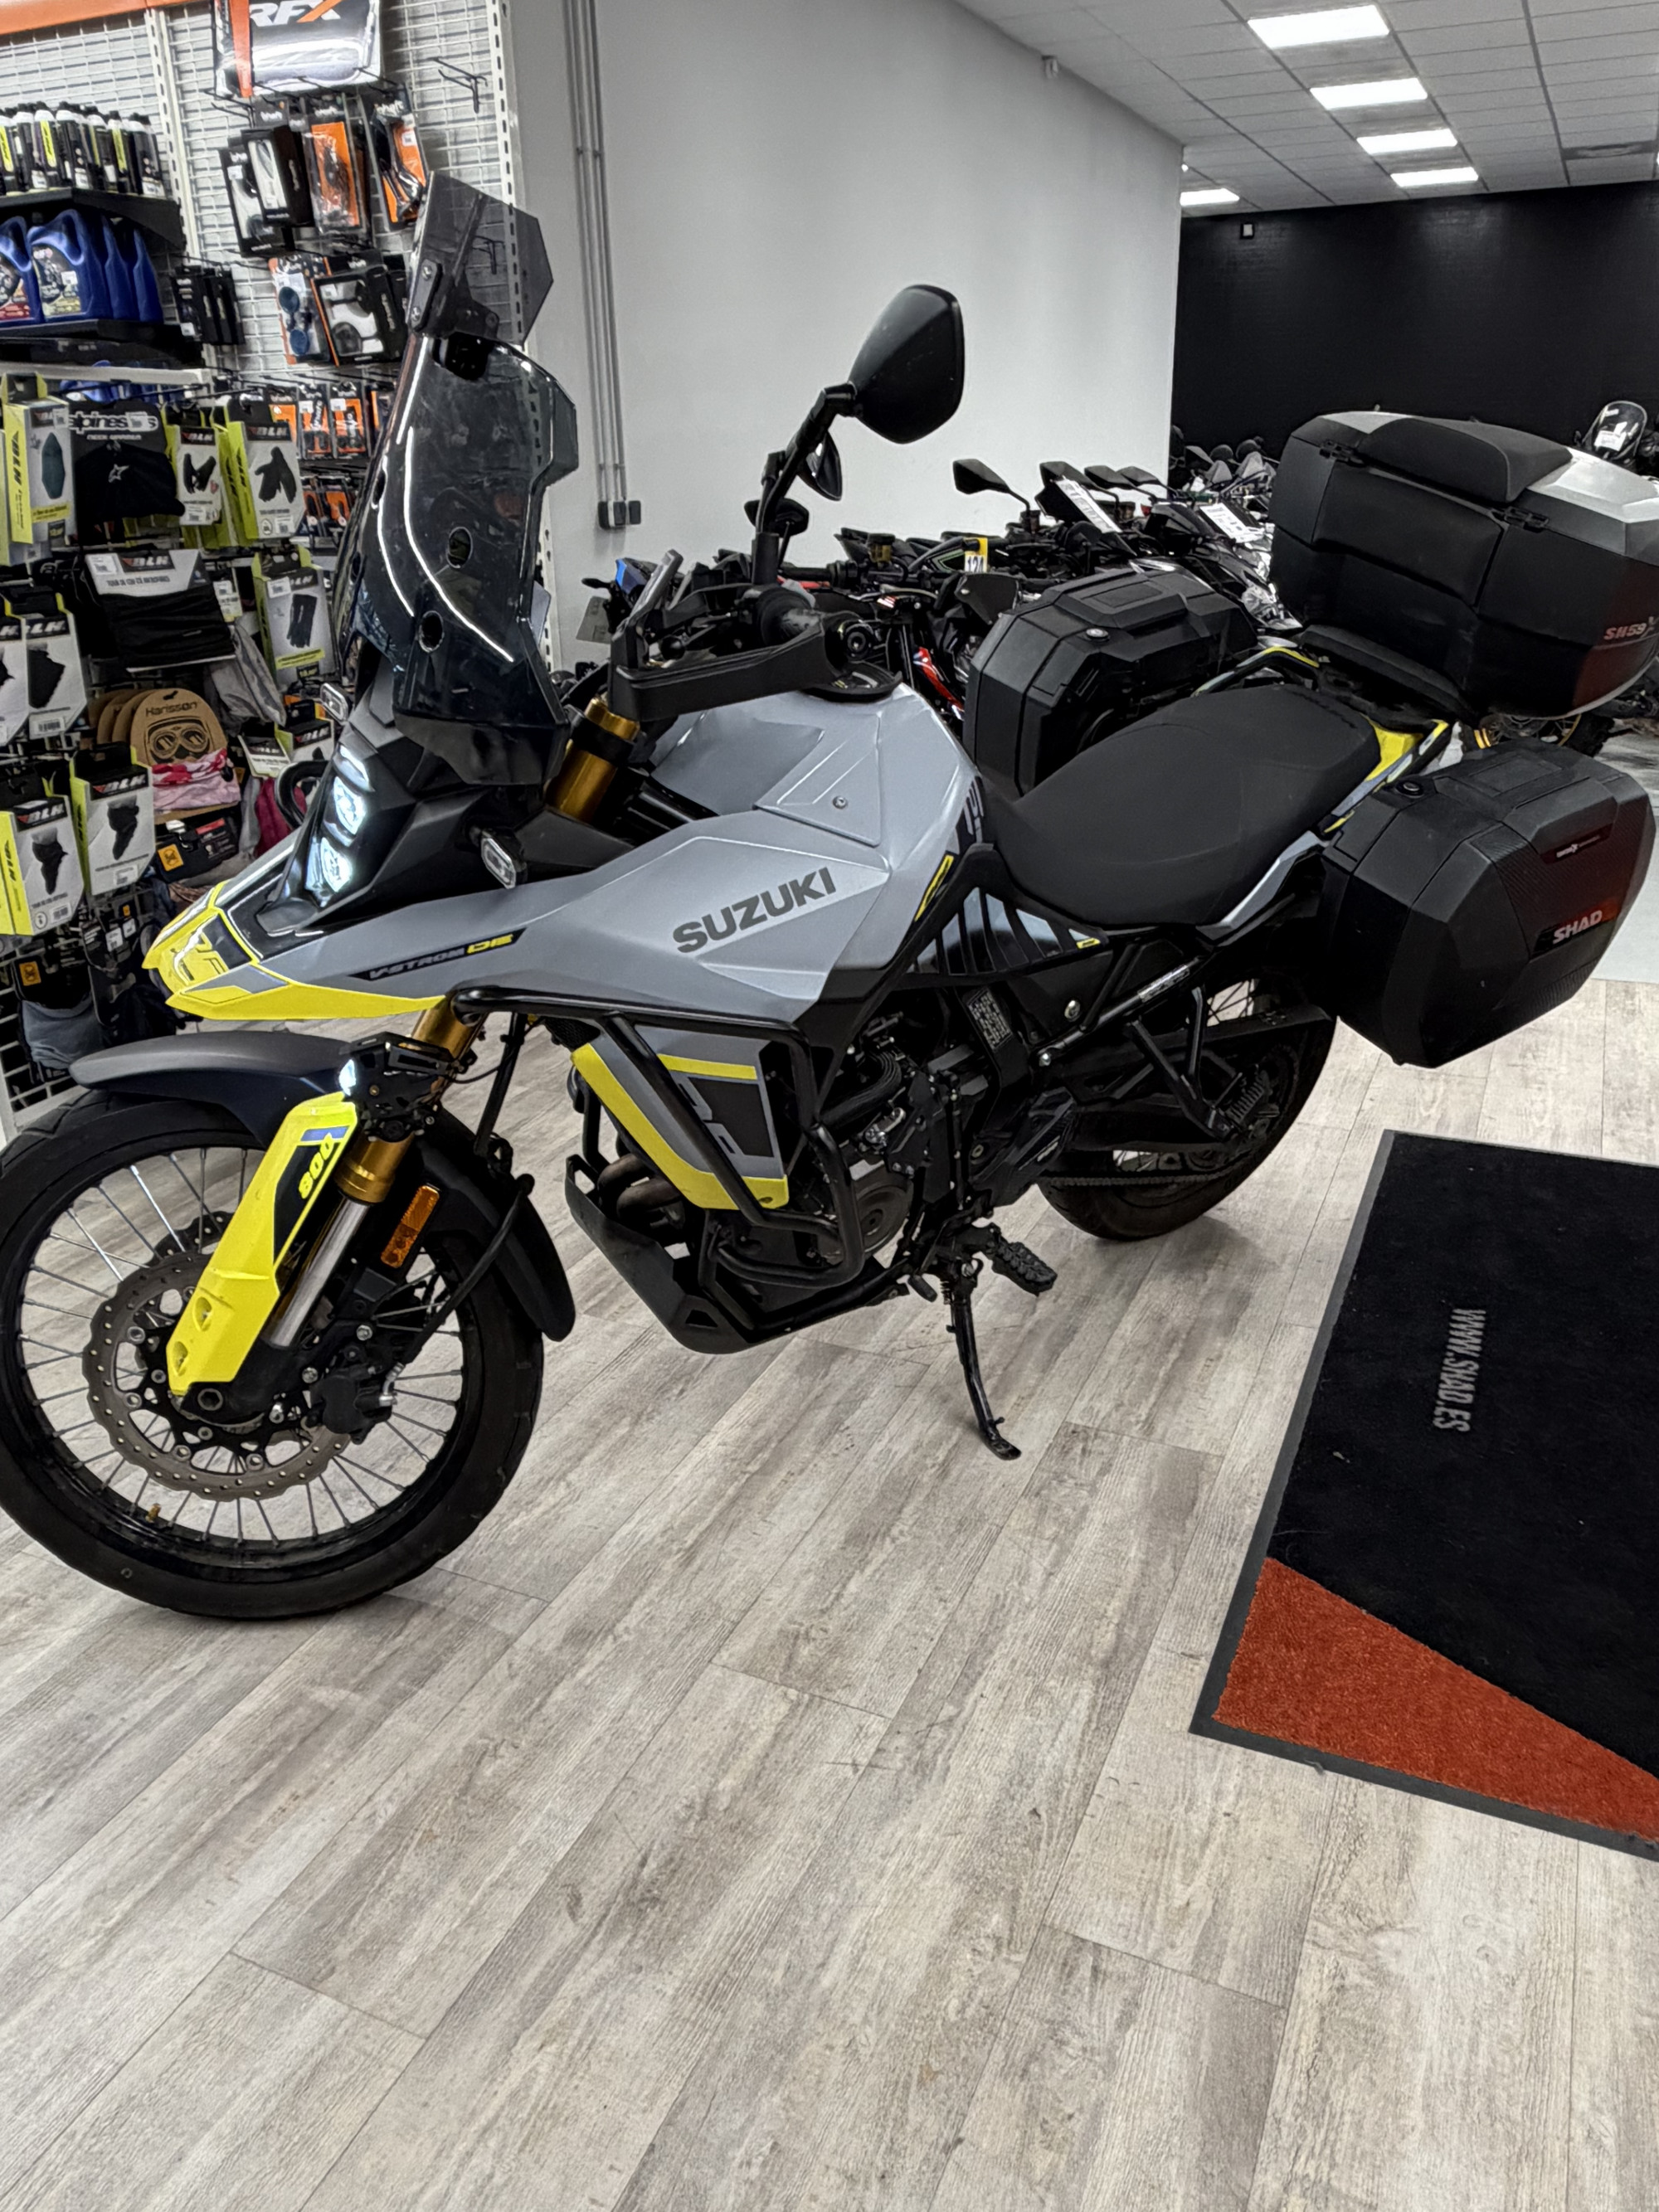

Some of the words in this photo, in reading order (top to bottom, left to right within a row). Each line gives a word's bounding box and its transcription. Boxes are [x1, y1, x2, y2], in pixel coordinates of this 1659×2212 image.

[250, 0, 343, 27] RFX
[673, 867, 836, 953] SUZUKI
[1552, 909, 1603, 945] SHAD
[299, 1132, 334, 1199] 800
[1433, 1308, 1486, 1432] WWW.SHAD.ES
